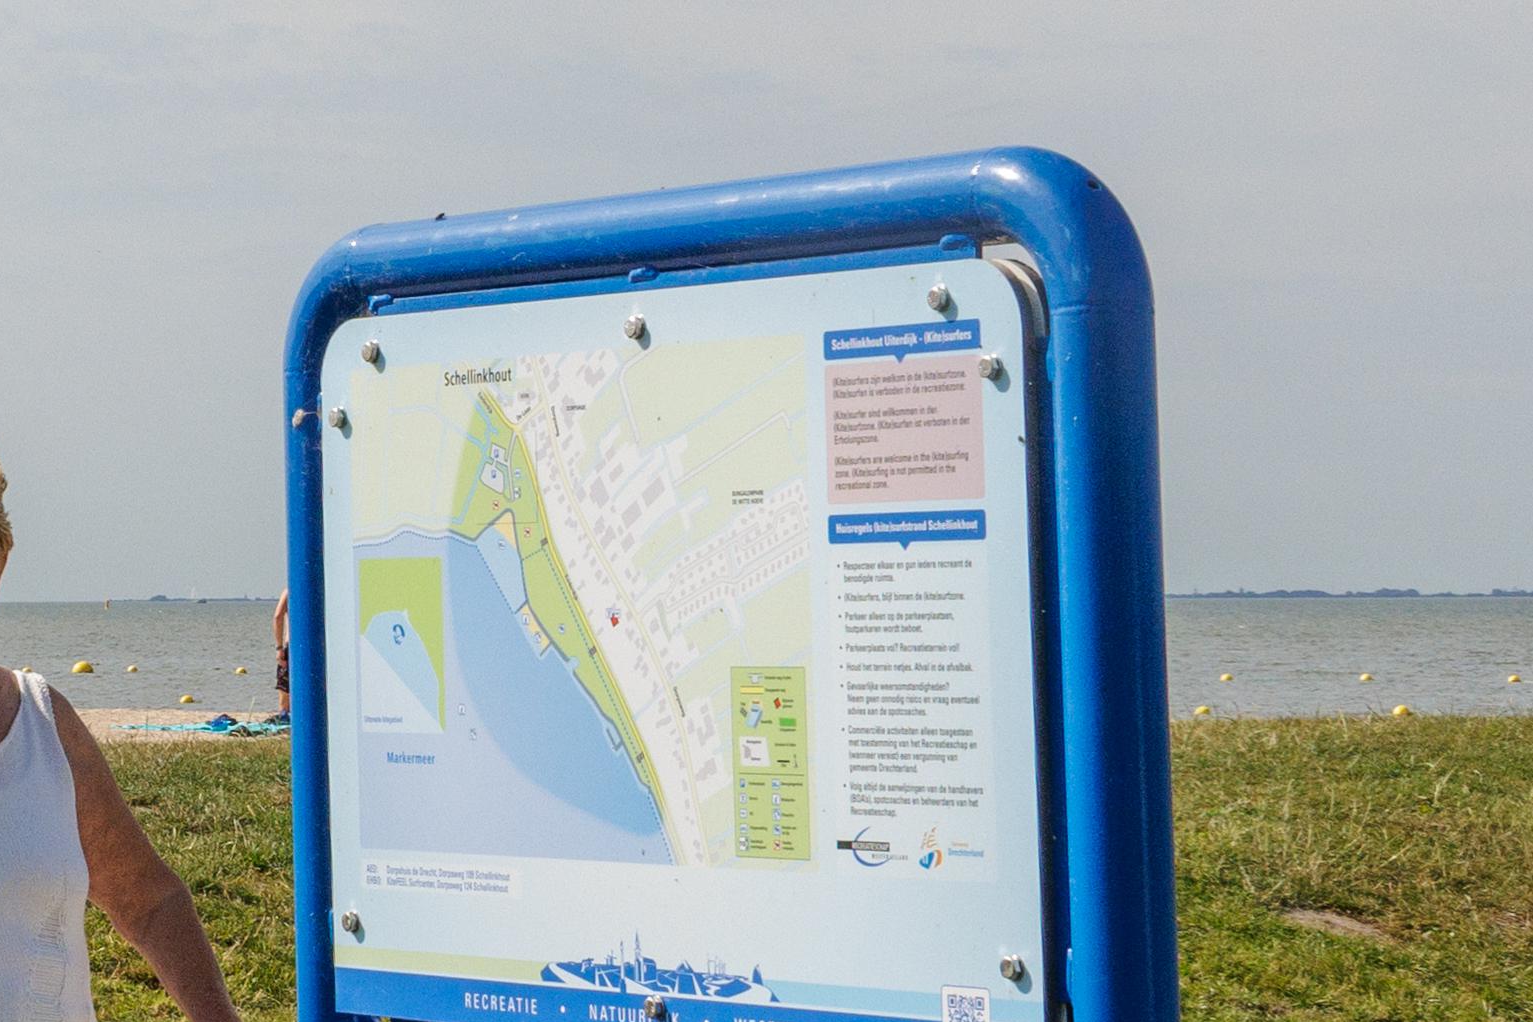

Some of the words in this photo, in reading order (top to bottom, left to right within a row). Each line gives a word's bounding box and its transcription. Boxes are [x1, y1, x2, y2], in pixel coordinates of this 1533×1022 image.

[831, 337, 883, 351] Schellinkhout
[444, 368, 512, 386] Schellinkhout
[928, 519, 978, 531] Schellinkhout
[387, 752, 435, 764] Markermeer
[465, 992, 537, 1015] RECREATIE
